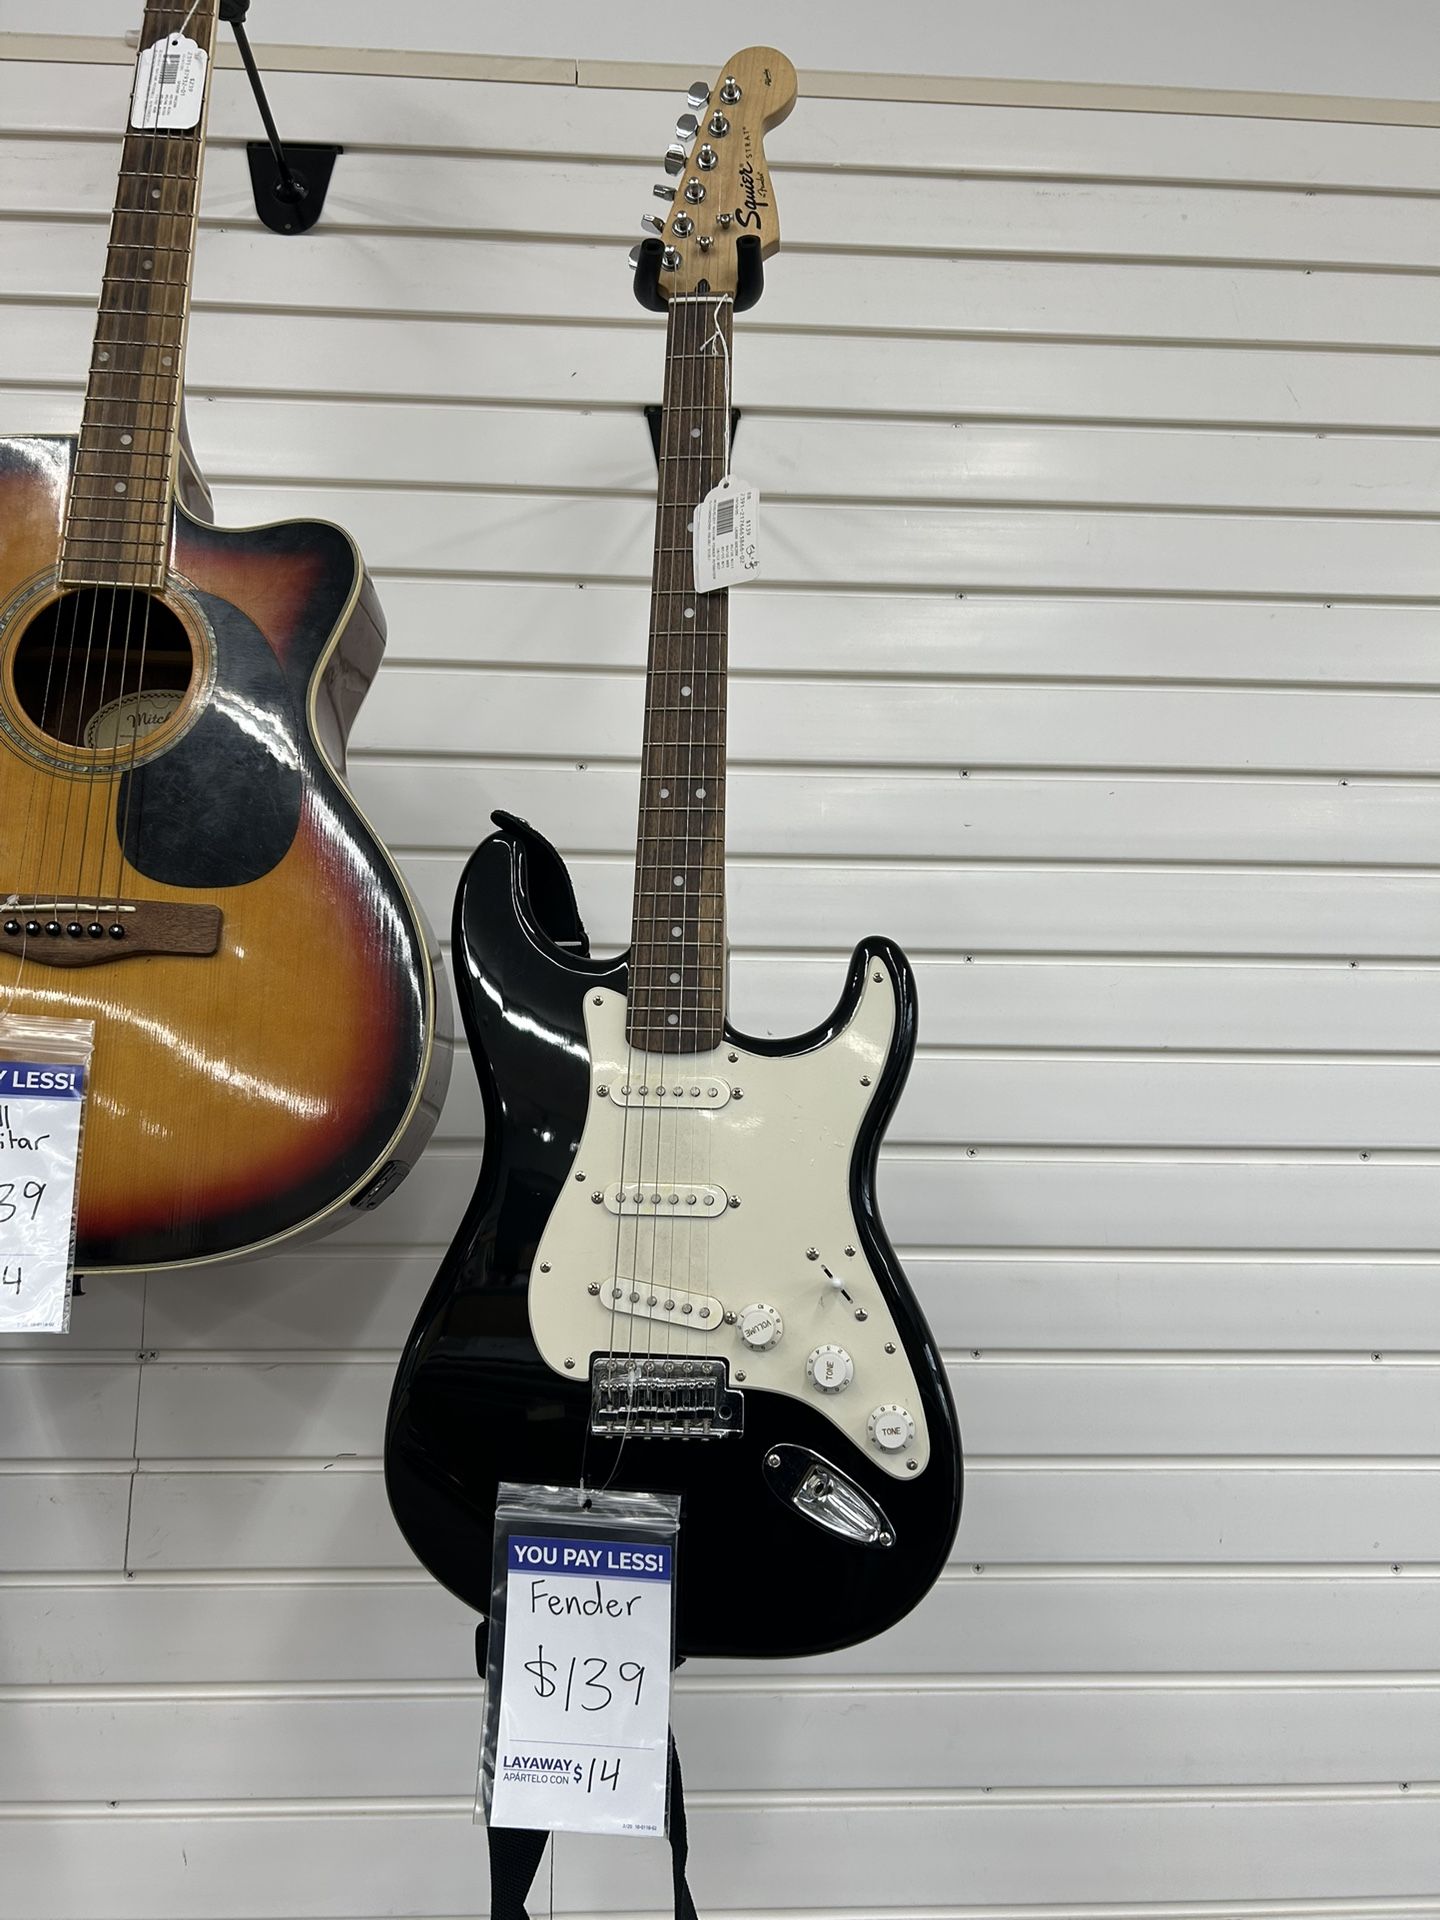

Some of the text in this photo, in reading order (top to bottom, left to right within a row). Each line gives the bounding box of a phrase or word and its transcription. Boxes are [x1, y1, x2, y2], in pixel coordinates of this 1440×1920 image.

[735, 161, 768, 230] Squier
[12, 1070, 75, 1090] LESS!
[0, 1181, 46, 1222] 39
[745, 1320, 771, 1337] VOLUME
[882, 1427, 901, 1436] TONE
[514, 1545, 663, 1572] YOU PAY LESS!
[531, 1579, 642, 1618] Fender
[524, 1644, 645, 1712] $139
[503, 1755, 572, 1771] LAYAWAY
[503, 1771, 569, 1784] APÁRTELO CON
